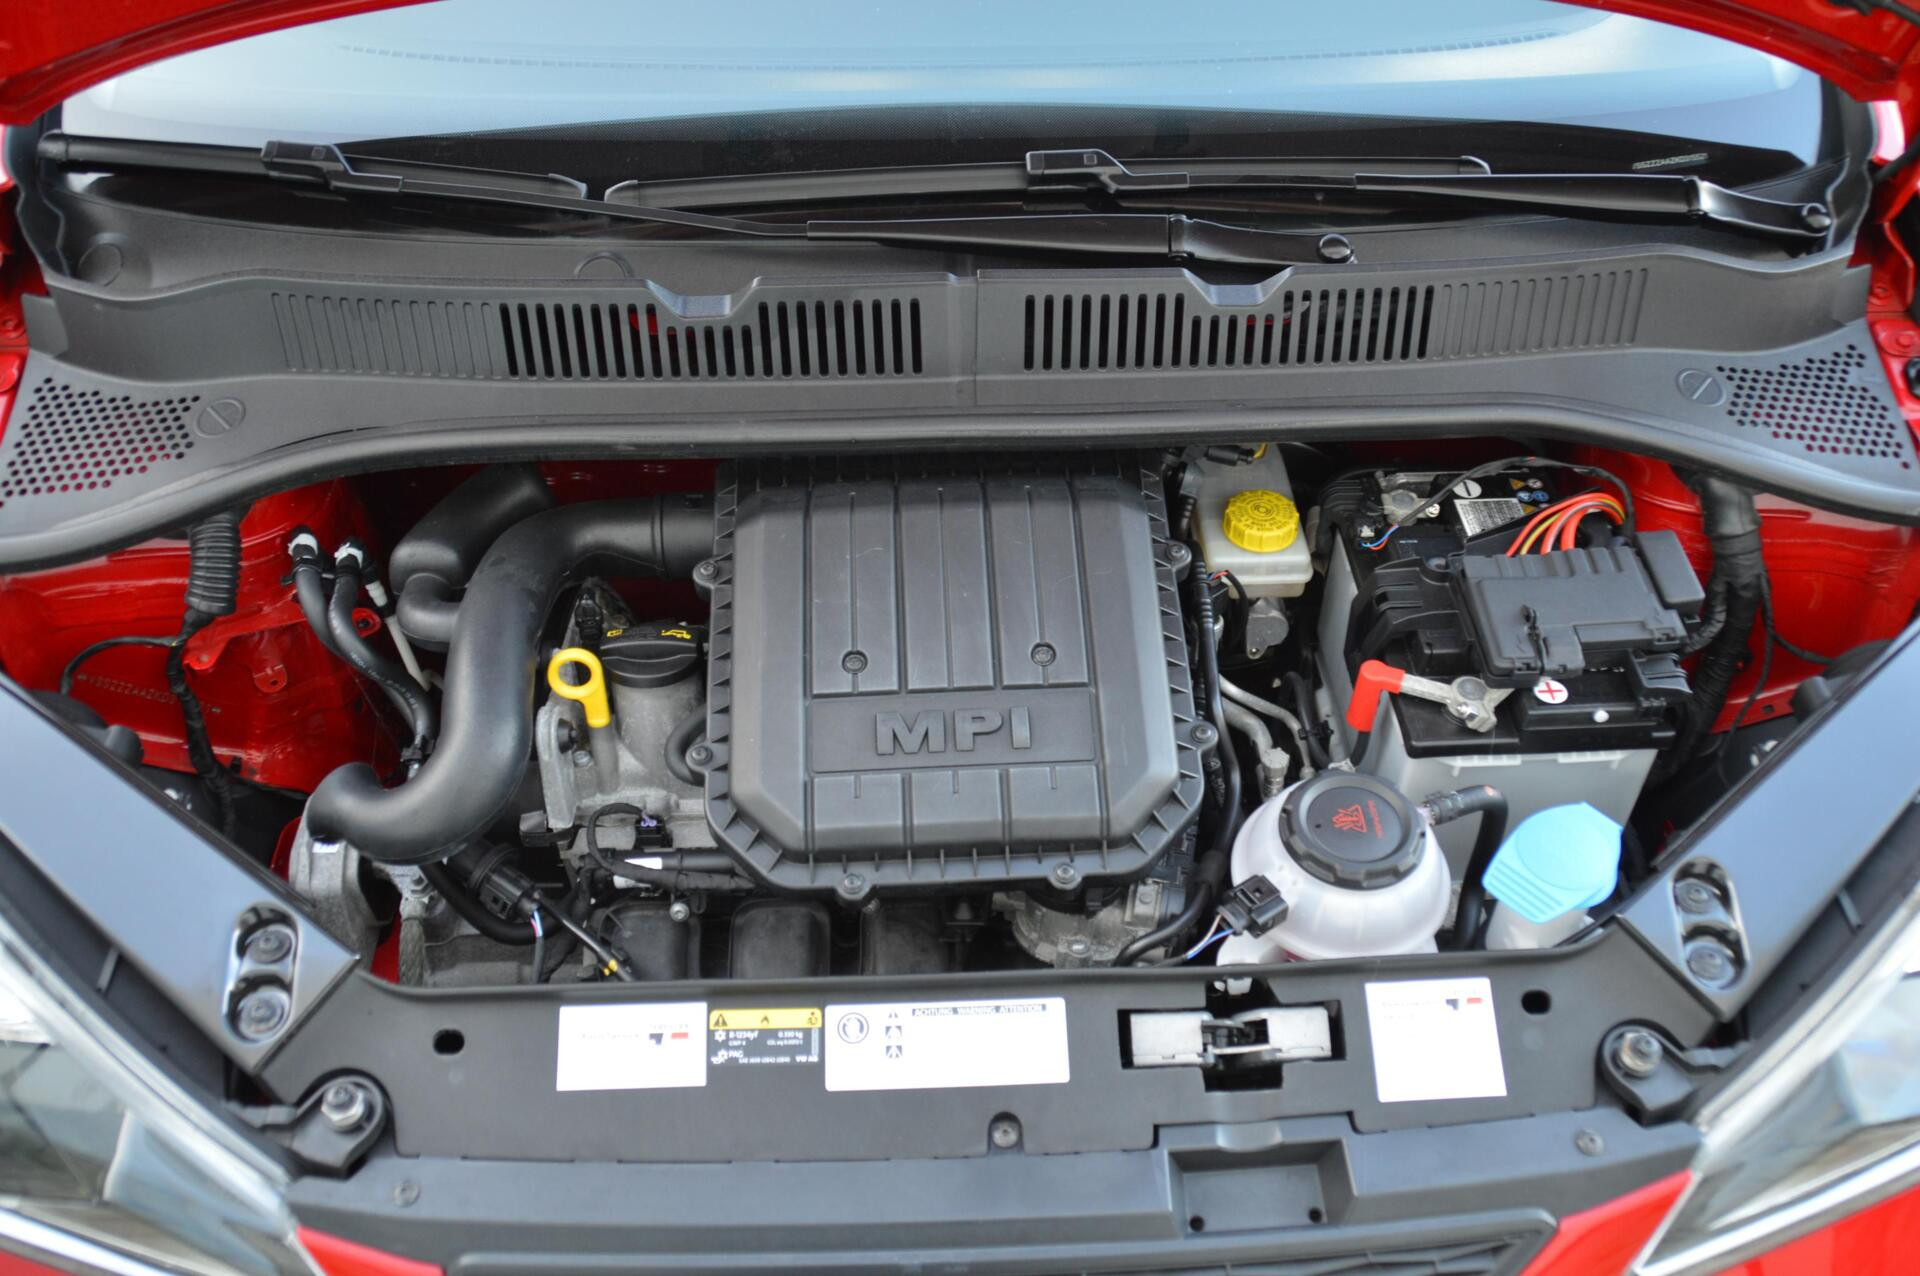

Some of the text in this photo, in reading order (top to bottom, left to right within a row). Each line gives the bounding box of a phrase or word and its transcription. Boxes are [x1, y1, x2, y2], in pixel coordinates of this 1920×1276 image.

[875, 706, 1032, 756] MPI
[914, 1004, 1043, 1017] ACHTUNG WARNING ATTENTION
